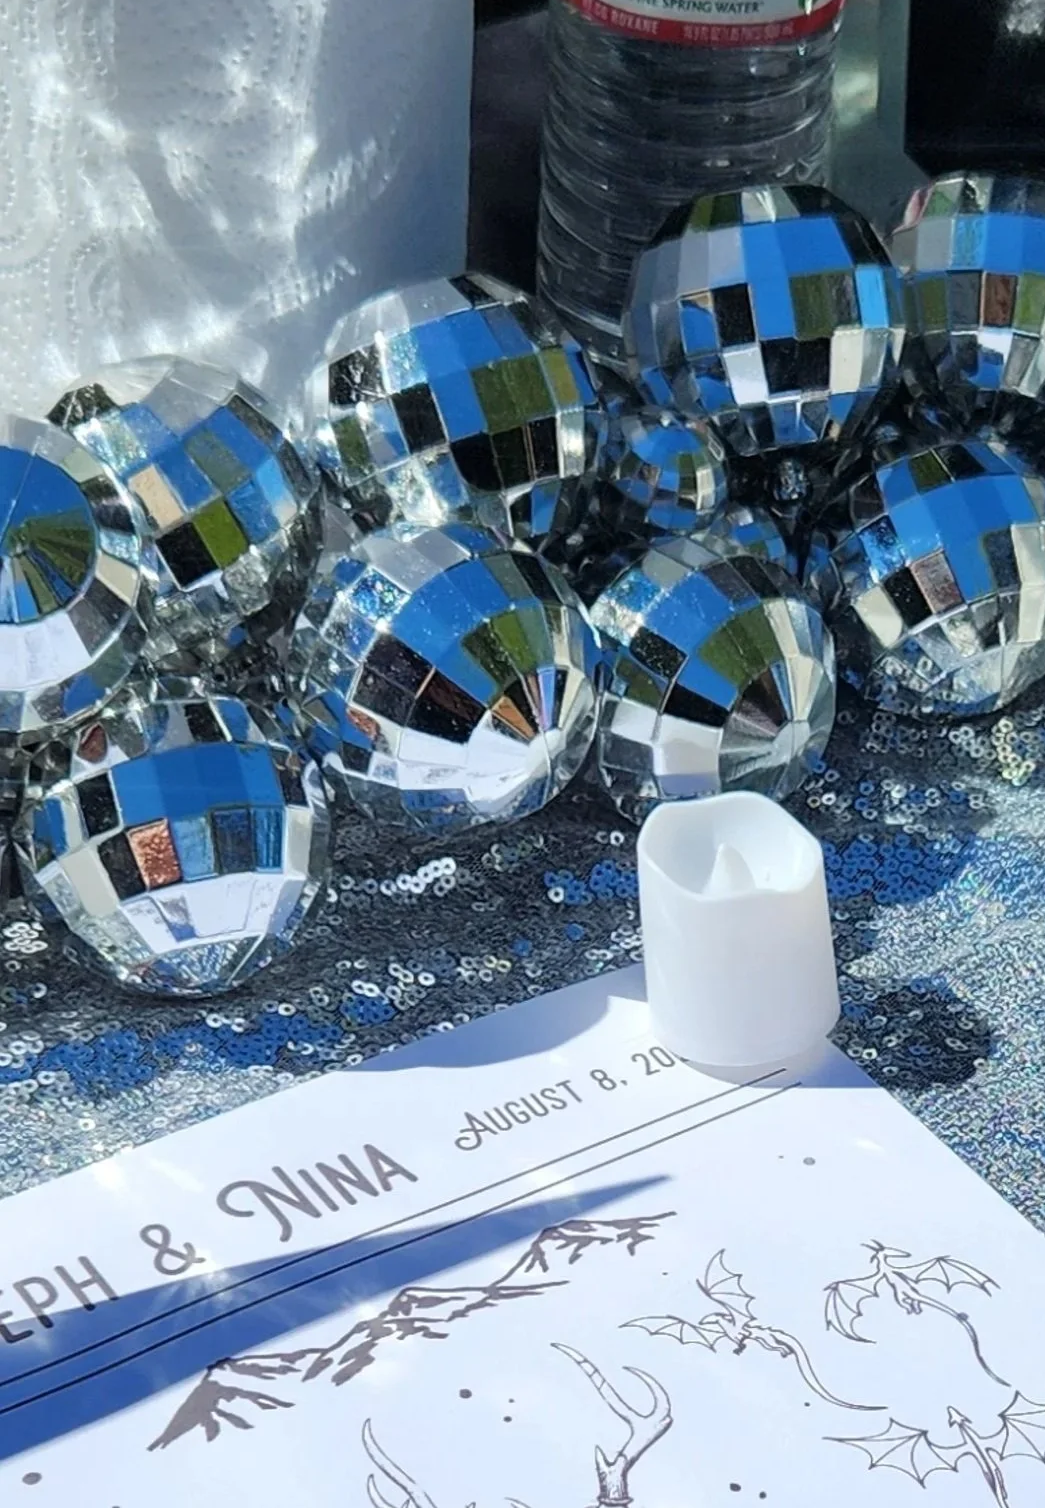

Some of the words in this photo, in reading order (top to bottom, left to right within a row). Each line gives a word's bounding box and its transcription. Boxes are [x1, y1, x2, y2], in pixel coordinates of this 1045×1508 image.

[454, 1079, 583, 1152] AUGUST
[590, 1068, 628, 1092] 8,
[631, 1046, 690, 1076] 20
[139, 1224, 206, 1276] &
[216, 1144, 419, 1243] NINA
